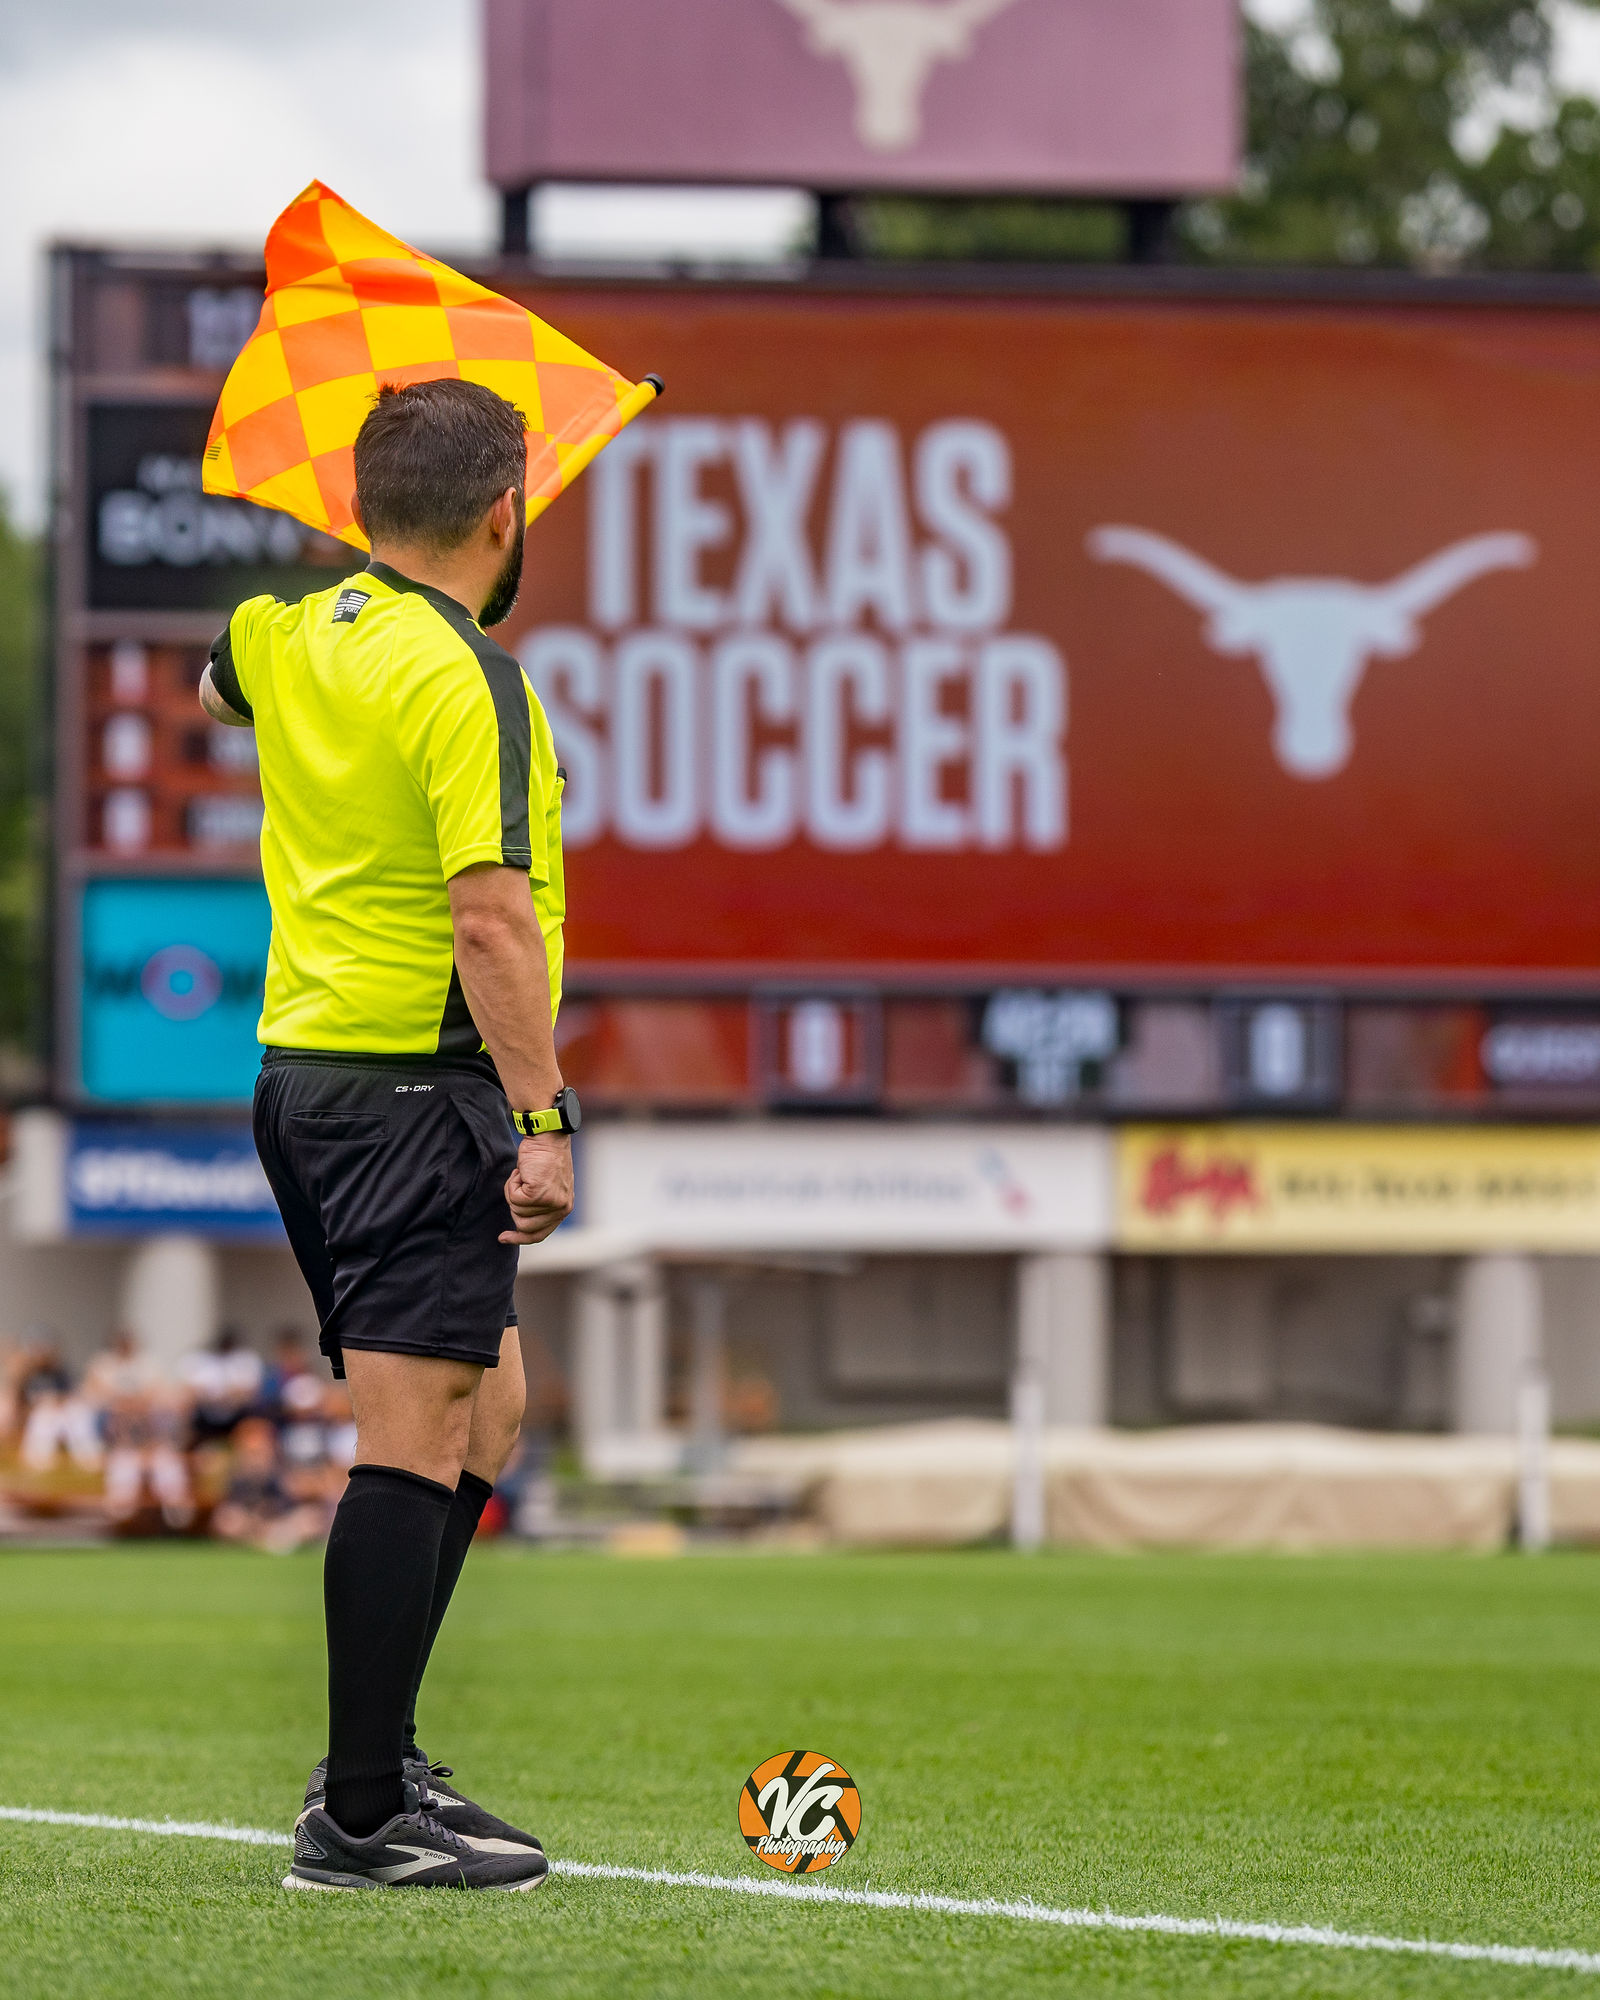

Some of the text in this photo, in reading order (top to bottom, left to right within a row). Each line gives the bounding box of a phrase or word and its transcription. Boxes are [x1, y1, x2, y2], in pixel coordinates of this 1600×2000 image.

[588, 418, 1012, 630] TEXAS
[517, 626, 1067, 850] SOCCER
[431, 1792, 458, 1804] BROOKS
[424, 1850, 451, 1861] BROOKS
